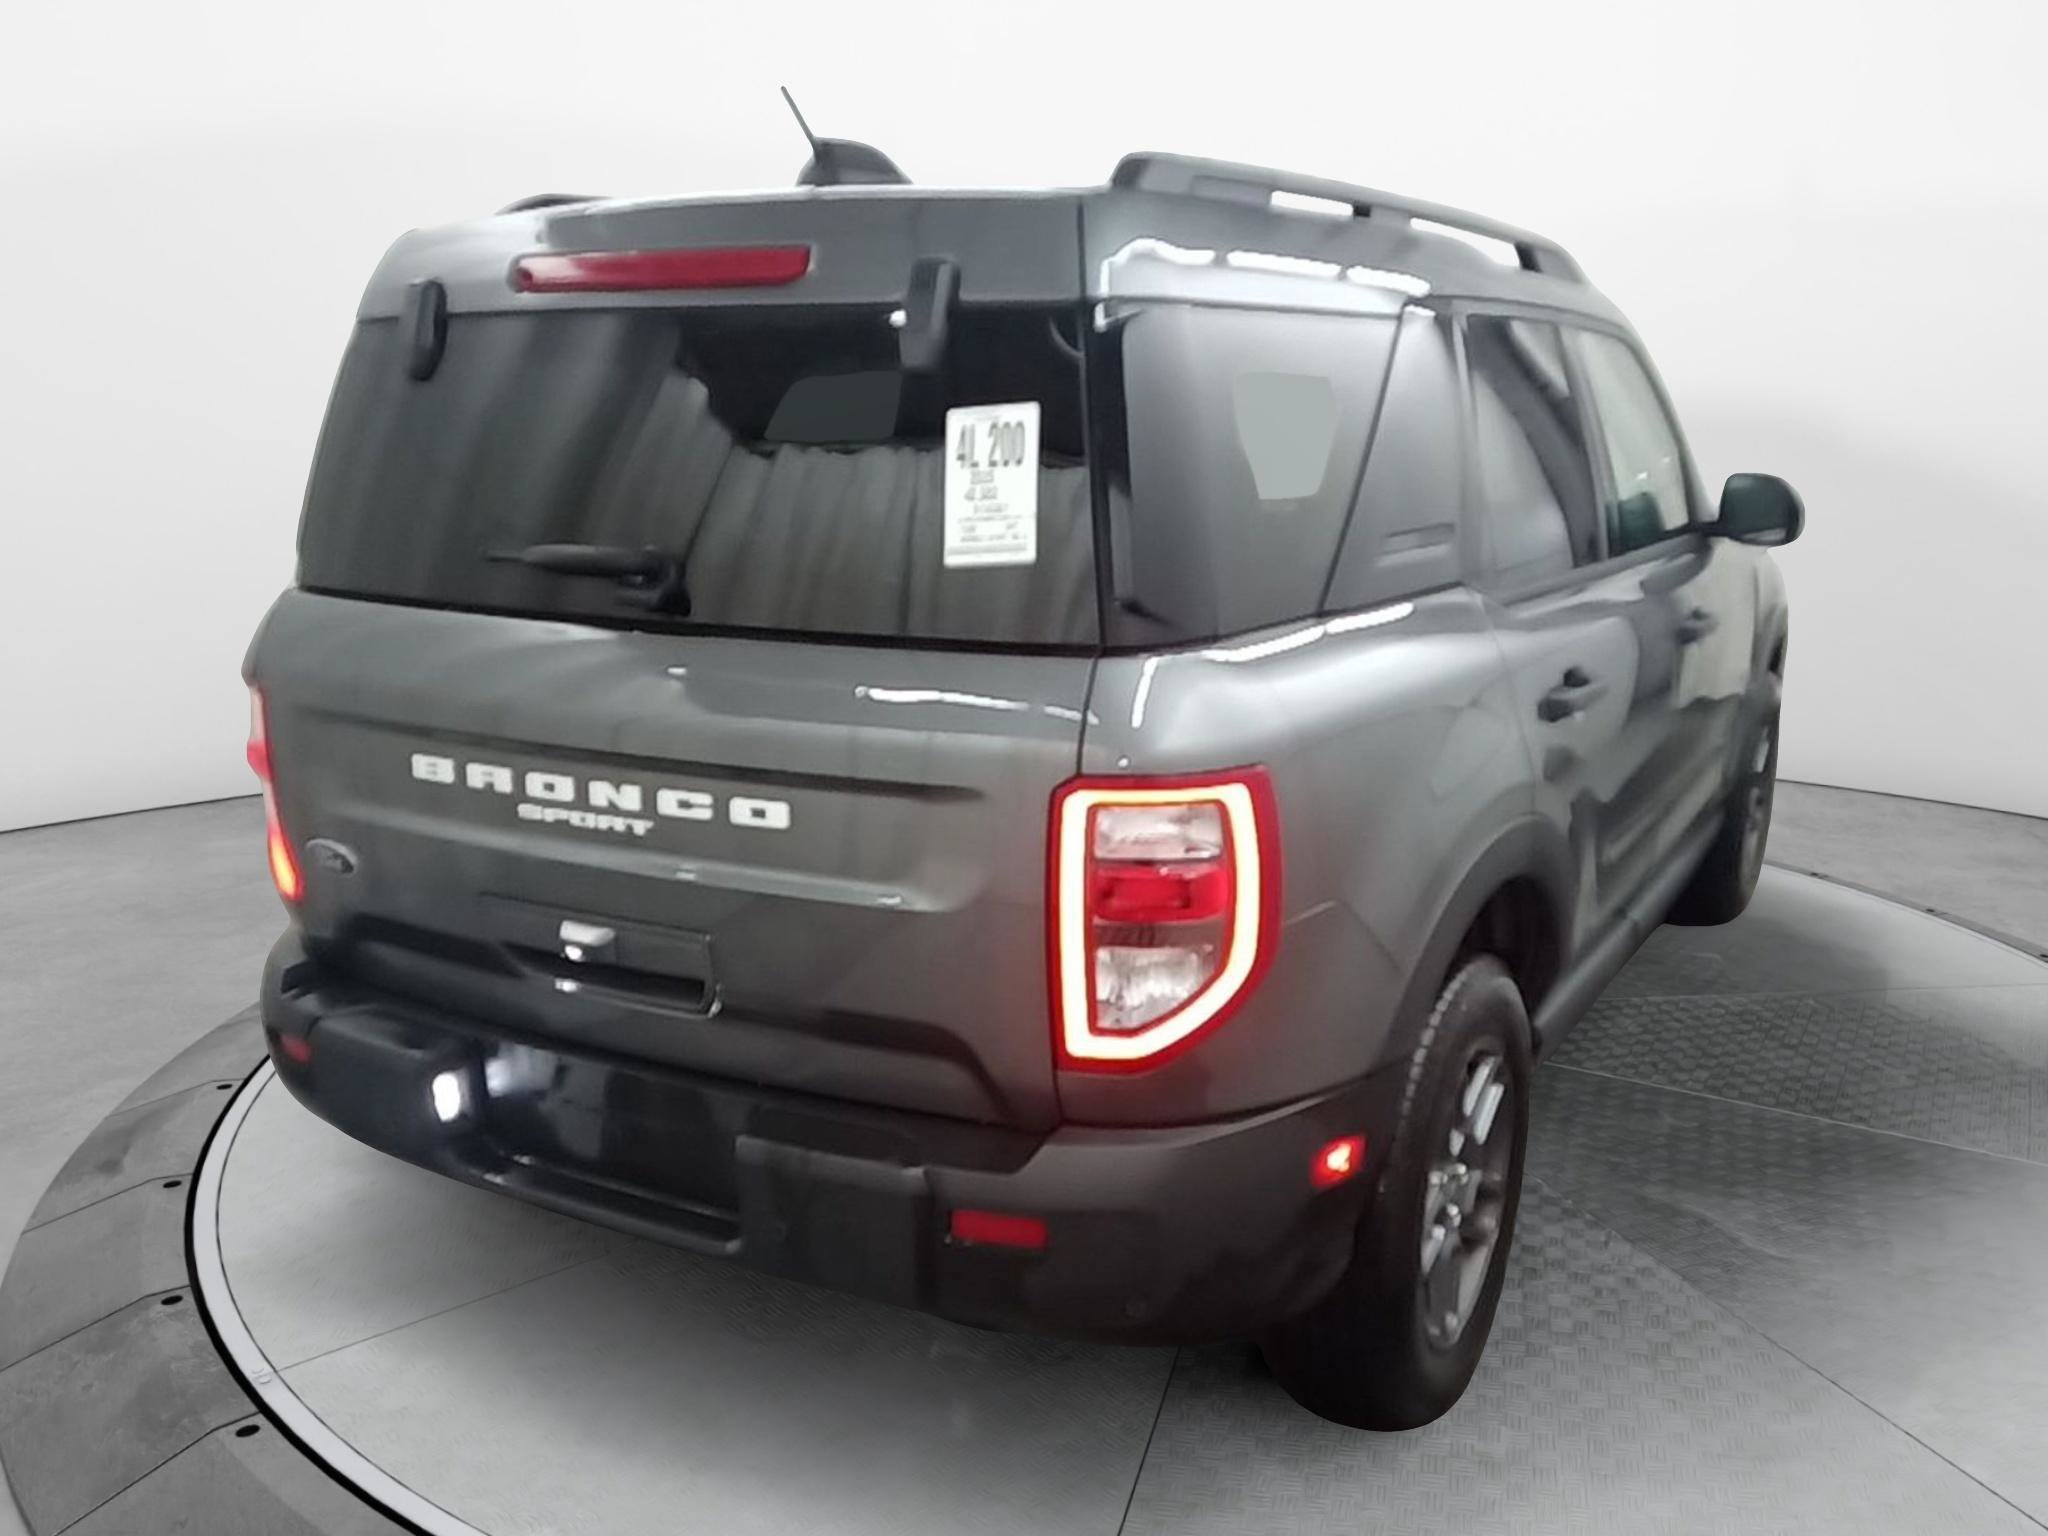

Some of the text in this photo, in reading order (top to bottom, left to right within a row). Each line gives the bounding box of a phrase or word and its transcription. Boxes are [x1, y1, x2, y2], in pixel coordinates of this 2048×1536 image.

[988, 420, 1025, 468] 200
[411, 753, 791, 830] BRONCO
[517, 803, 654, 836] SPORT
